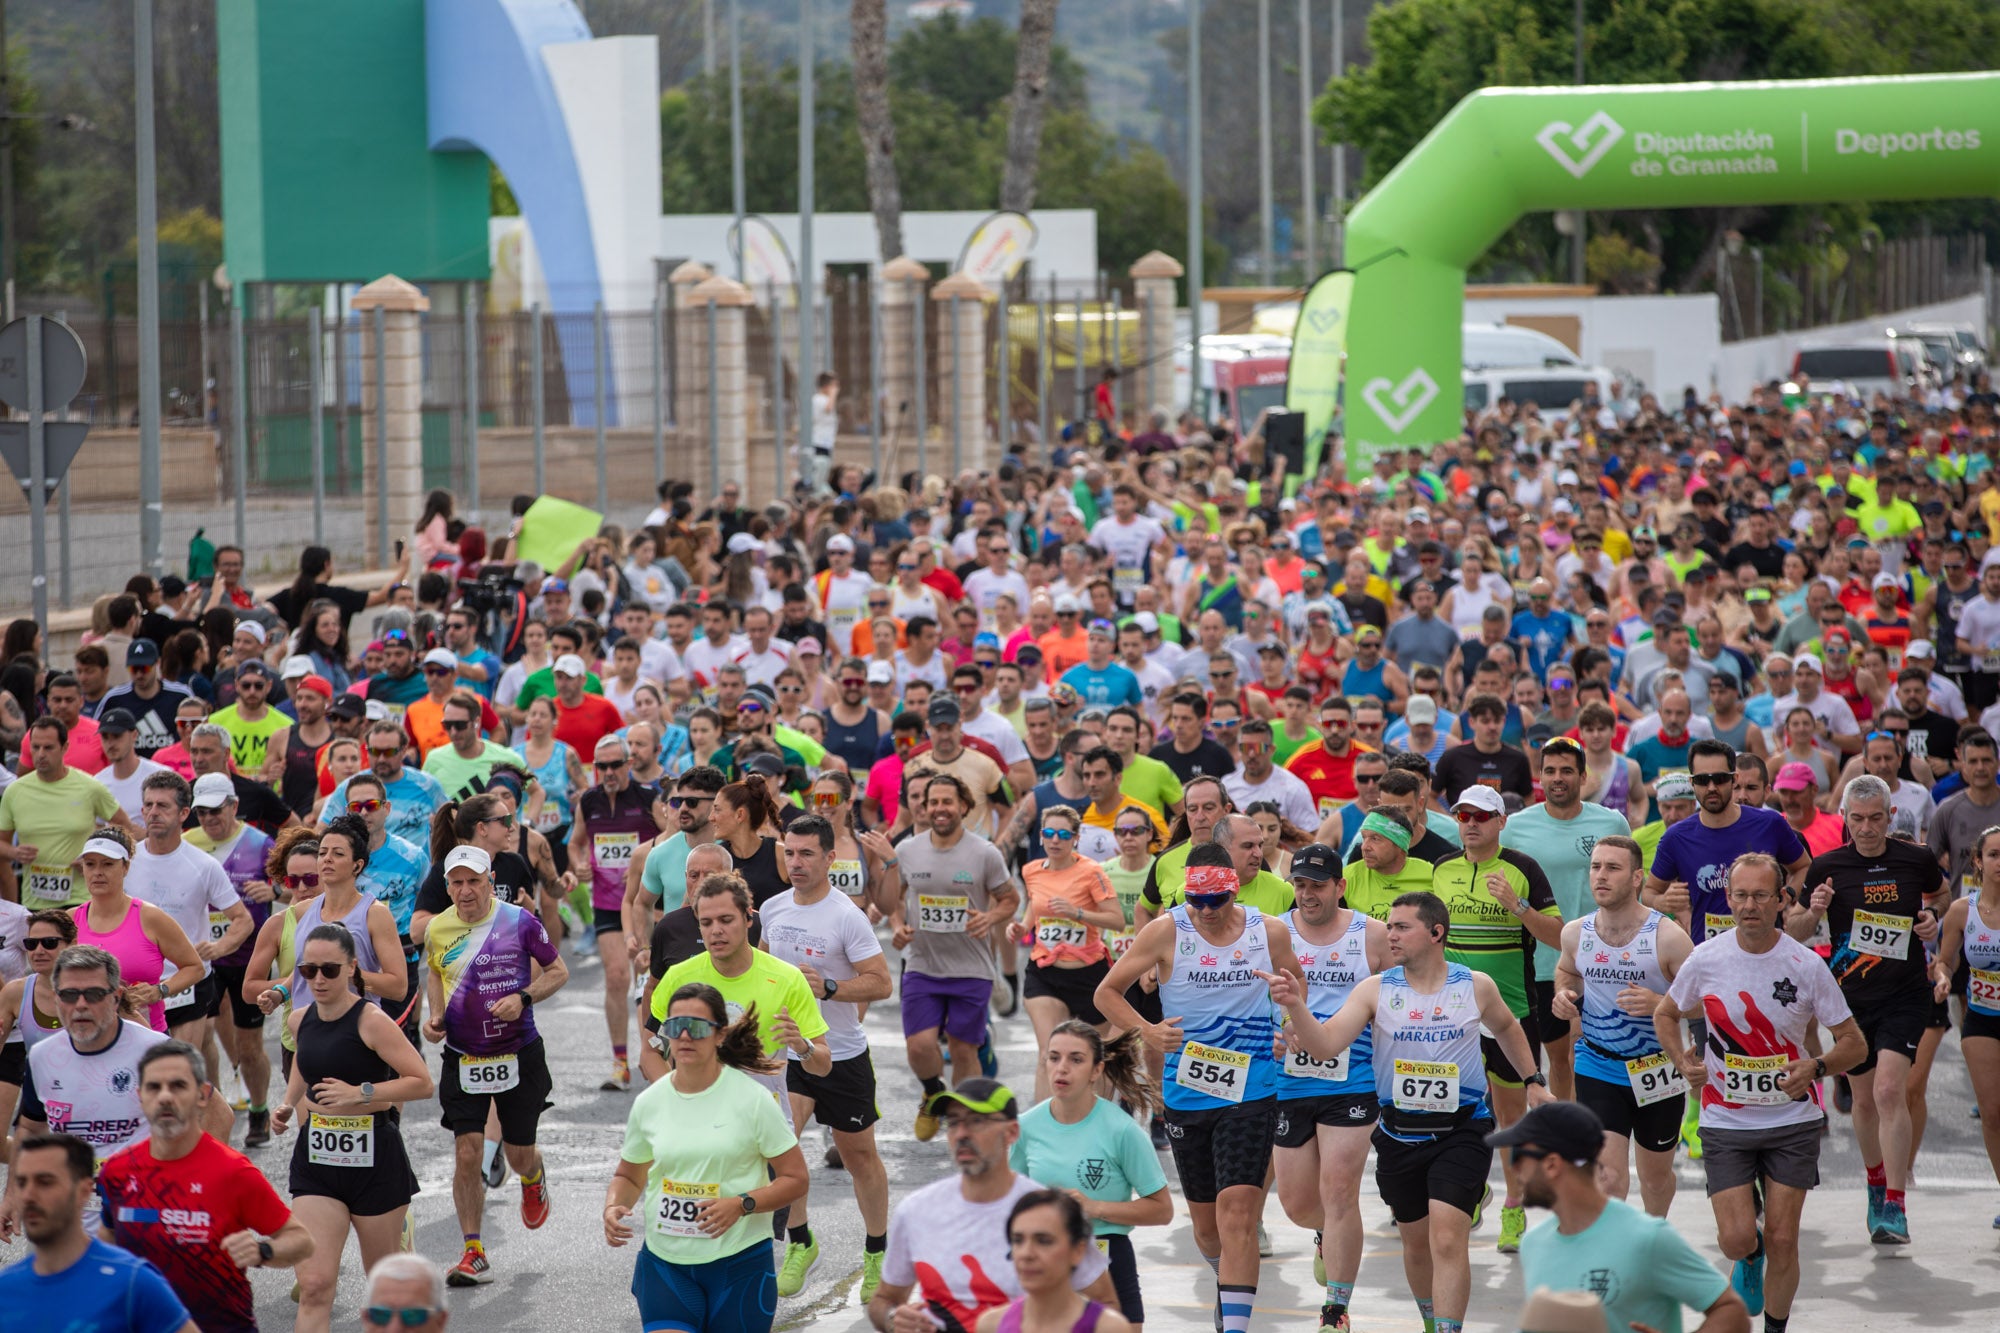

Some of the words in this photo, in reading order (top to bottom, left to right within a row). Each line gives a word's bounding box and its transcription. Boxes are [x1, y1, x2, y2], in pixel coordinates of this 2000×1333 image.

[1634, 129, 1774, 156] Diputación
[1836, 127, 1982, 158] Deportes
[1631, 157, 1662, 176] de
[1668, 154, 1777, 176] Granada
[601, 846, 631, 859] 292
[31, 875, 70, 891] 3230
[1864, 884, 1897, 893] FONDO
[1865, 891, 1899, 904] 2025
[921, 908, 966, 923] 3337
[1040, 928, 1084, 943] 3217
[1860, 925, 1901, 946] 997
[1187, 969, 1260, 982] MARACENA
[1585, 967, 1646, 980] MARACENA
[479, 978, 518, 992] OKEYMAS
[1393, 1028, 1465, 1042] MARACENA
[1193, 1045, 1203, 1056] 38
[1202, 1051, 1236, 1063] FONDO
[1402, 1063, 1413, 1072] 38
[1413, 1066, 1446, 1075] FONDO
[1733, 1057, 1742, 1067] 38
[1742, 1061, 1776, 1069] FONDO
[470, 1064, 509, 1083] 568
[1188, 1060, 1236, 1088] 554
[1402, 1078, 1449, 1100] 673
[311, 1131, 368, 1153] 3061
[160, 1208, 210, 1227] SEUR
[660, 1197, 708, 1222] 329
